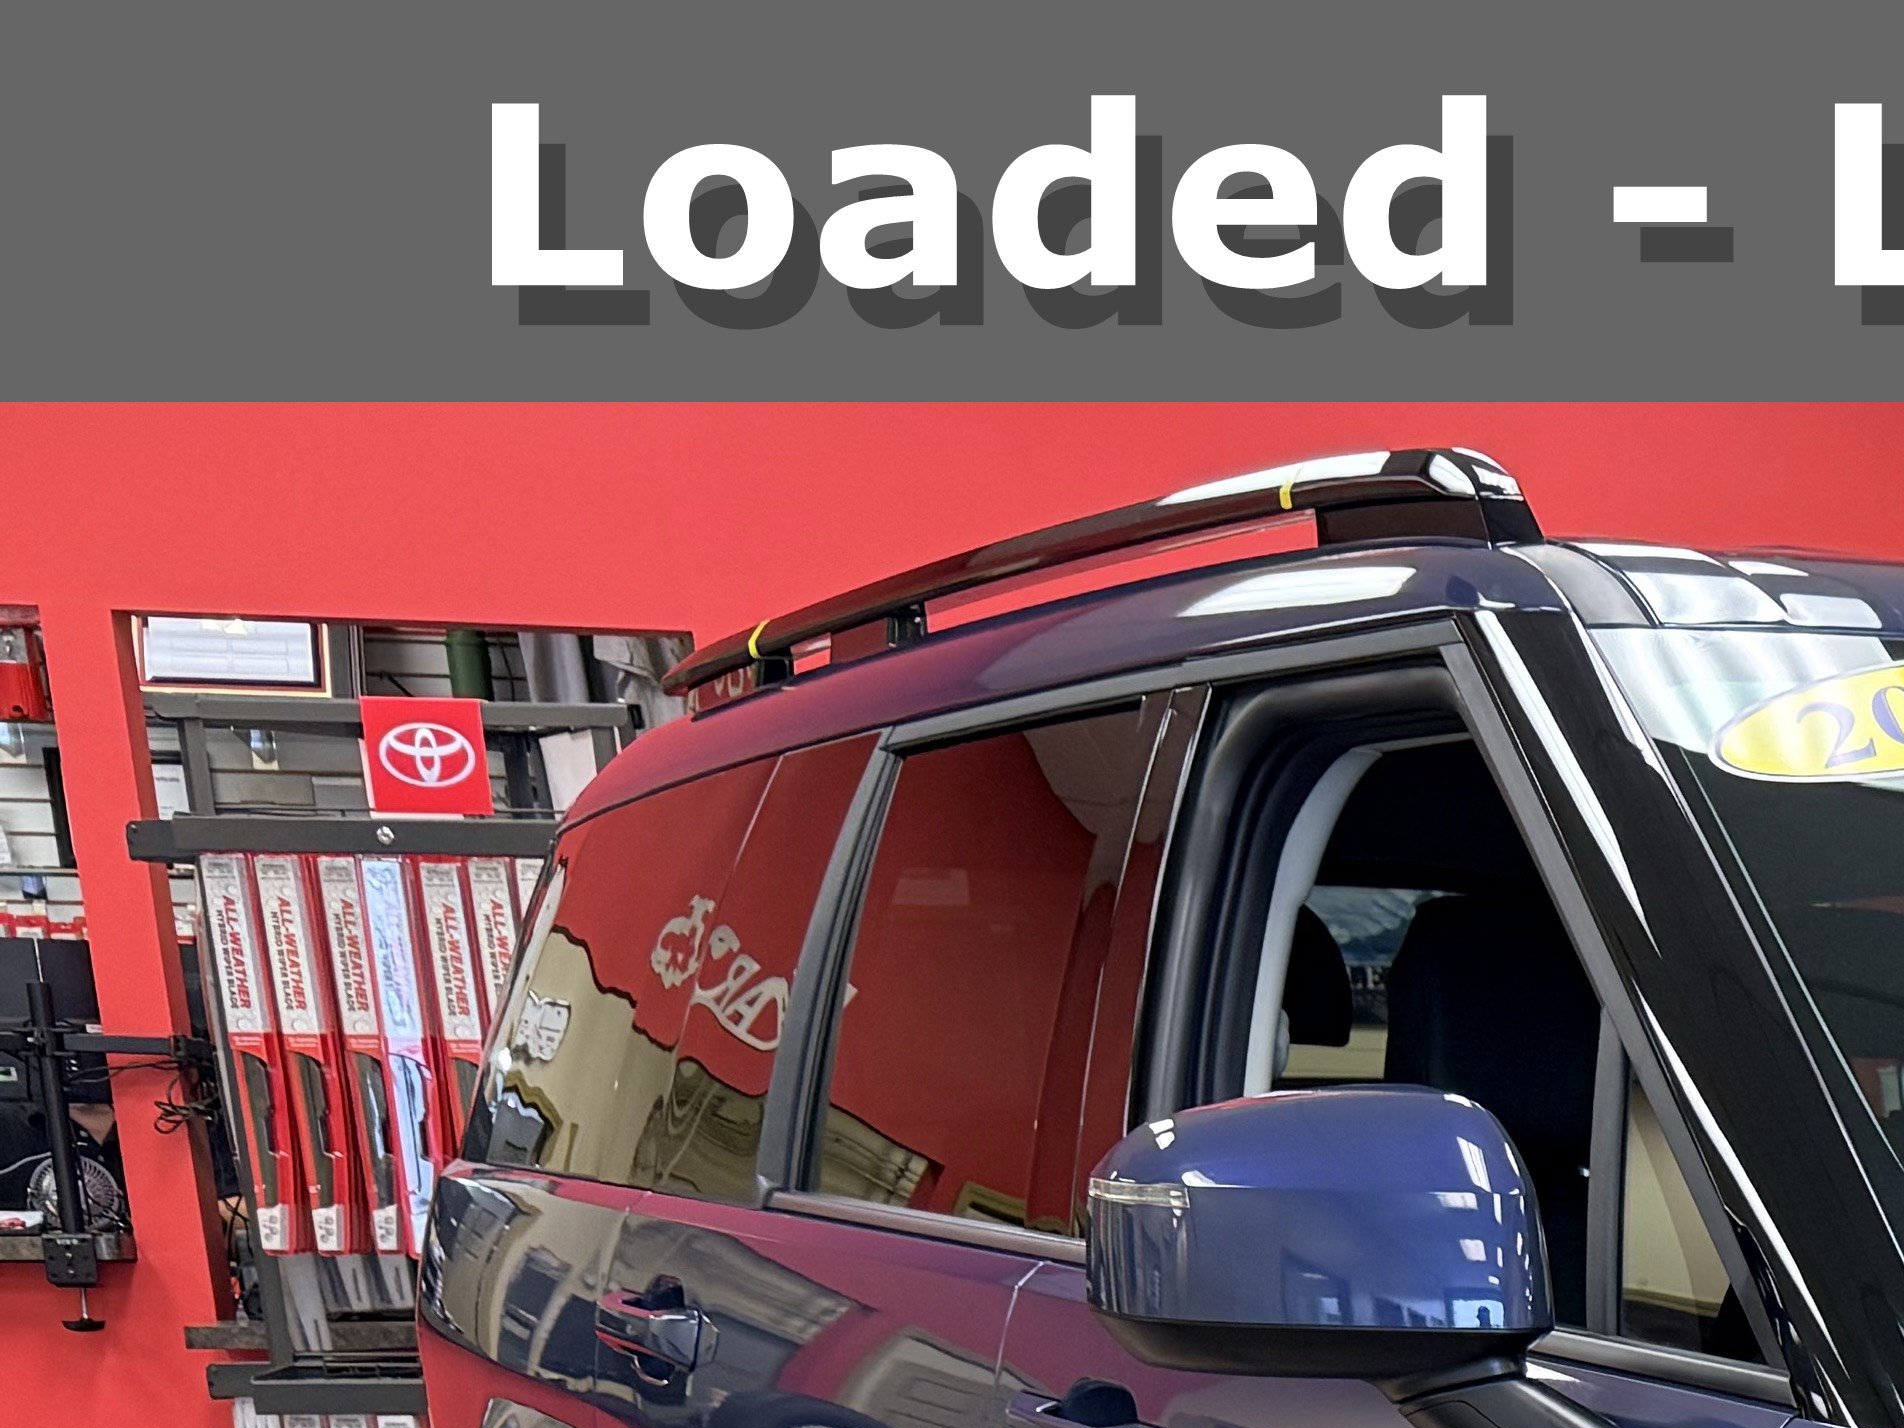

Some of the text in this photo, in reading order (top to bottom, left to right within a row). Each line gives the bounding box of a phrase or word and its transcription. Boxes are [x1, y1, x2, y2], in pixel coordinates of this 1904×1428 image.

[222, 895, 252, 1009] ALL-WEATHER
[277, 896, 307, 1011] ALL-WEATHER
[341, 898, 369, 1012] ALL-WEATHER
[442, 902, 470, 1017] ALL-WEATHER
